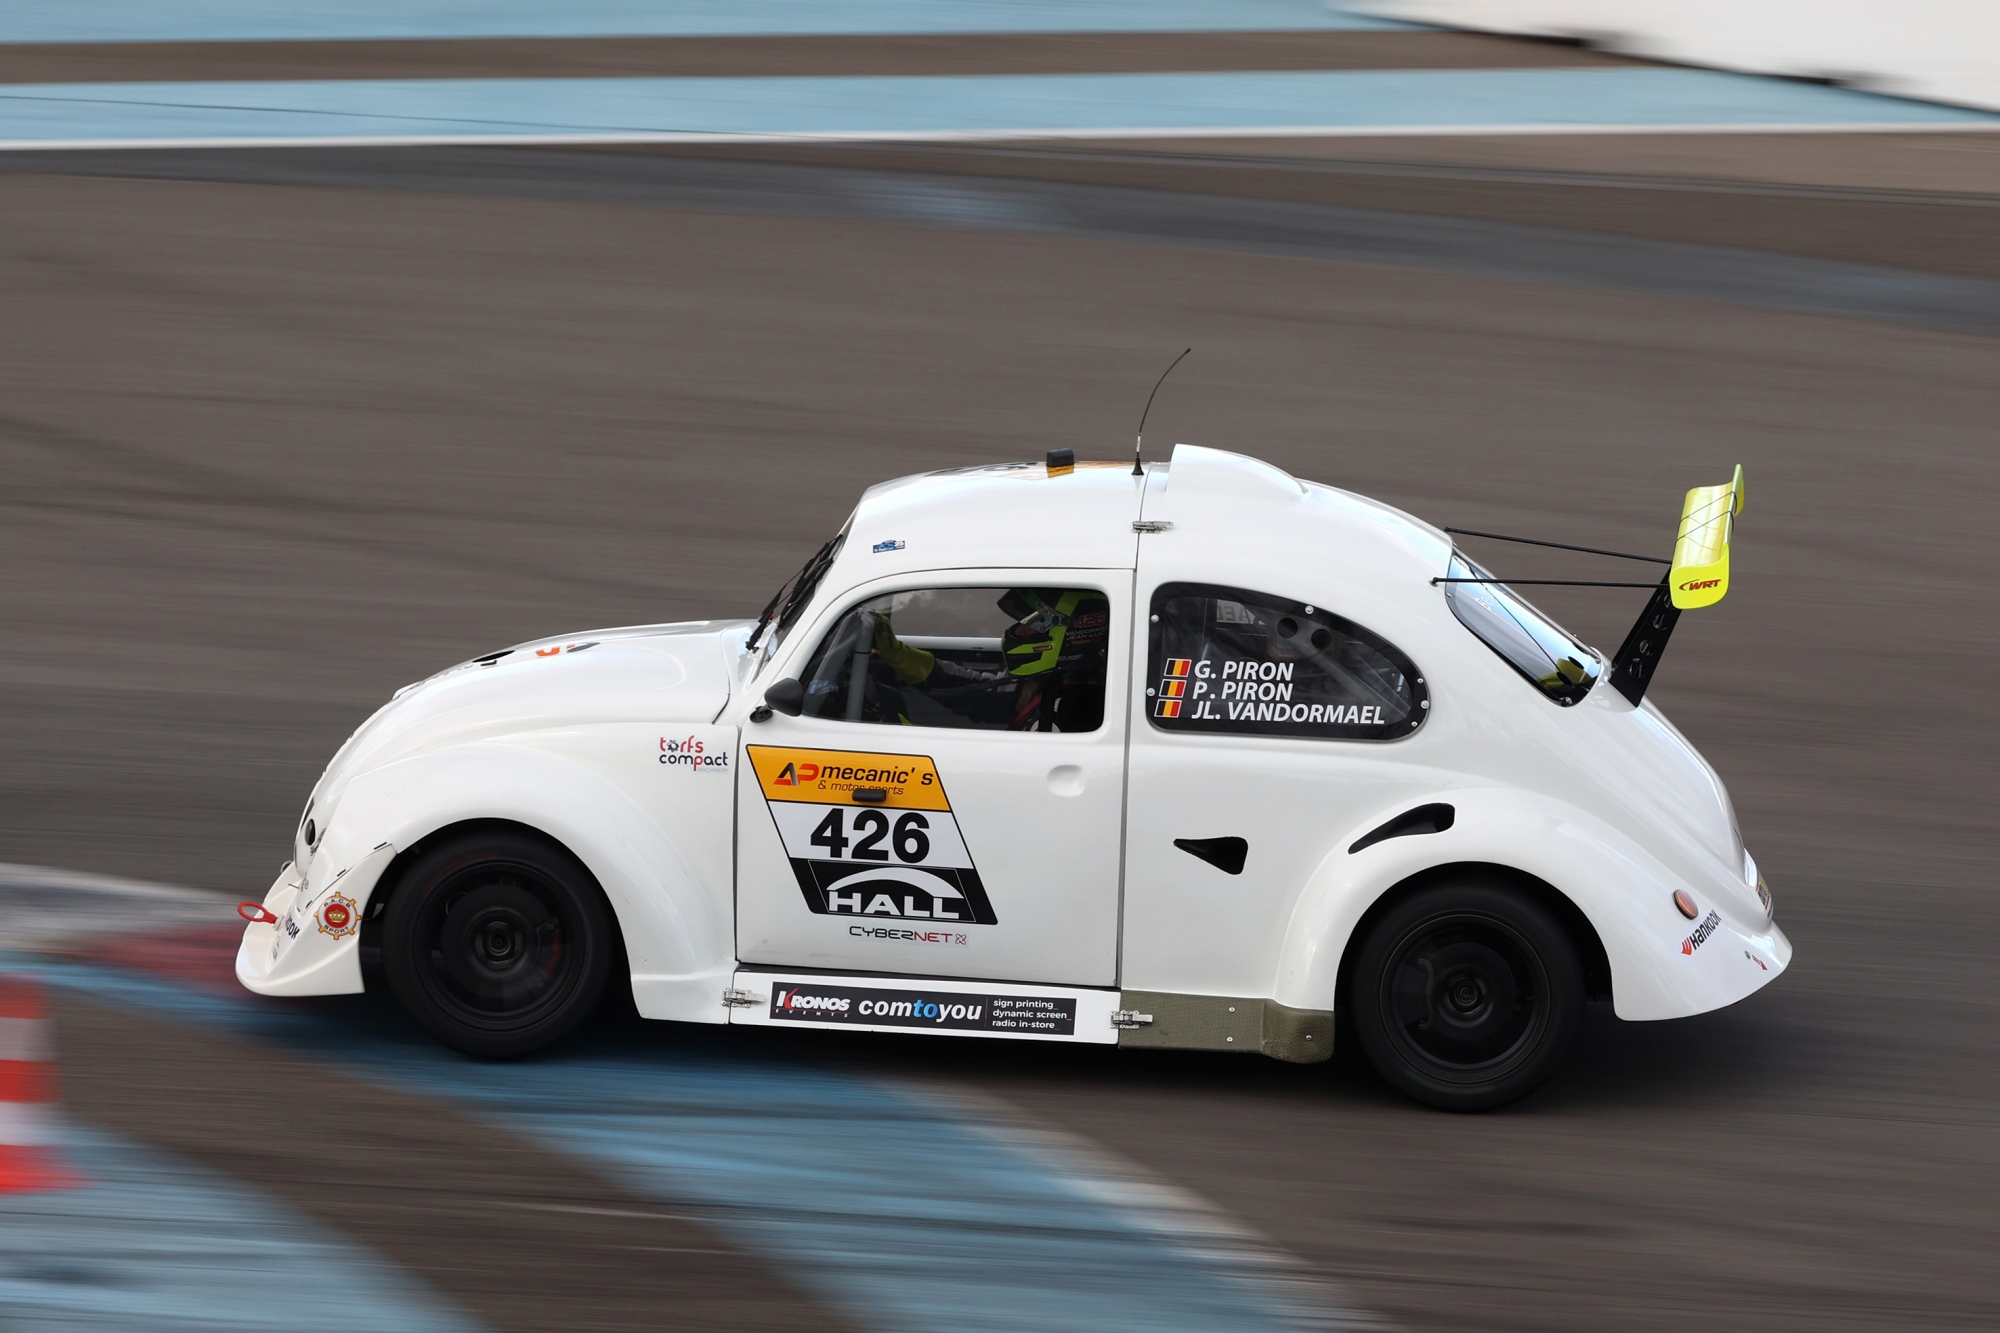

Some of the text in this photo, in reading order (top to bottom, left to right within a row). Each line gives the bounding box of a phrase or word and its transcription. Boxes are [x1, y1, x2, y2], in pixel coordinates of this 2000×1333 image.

[1689, 578, 1721, 591] WRT
[1074, 611, 1106, 628] 426
[1066, 630, 1105, 641] JEAN-LUC
[1194, 660, 1294, 681] G. PIRON
[1221, 682, 1293, 702] PIRON
[1191, 701, 1385, 725] JL. VANDORMAEL
[659, 752, 728, 772] compact
[773, 762, 819, 787] AP
[818, 779, 827, 790] &
[810, 808, 930, 864] 426
[829, 891, 960, 919] HALL
[323, 924, 349, 934] SPORT
[849, 926, 953, 943] CYBERNET
[776, 987, 851, 1011] KRONOS
[993, 998, 1014, 1008] sign
[775, 1008, 848, 1018] EVENTS
[858, 999, 982, 1023] comtoyou
[992, 1009, 1035, 1019] dynamic
[992, 1019, 1017, 1028] radio
